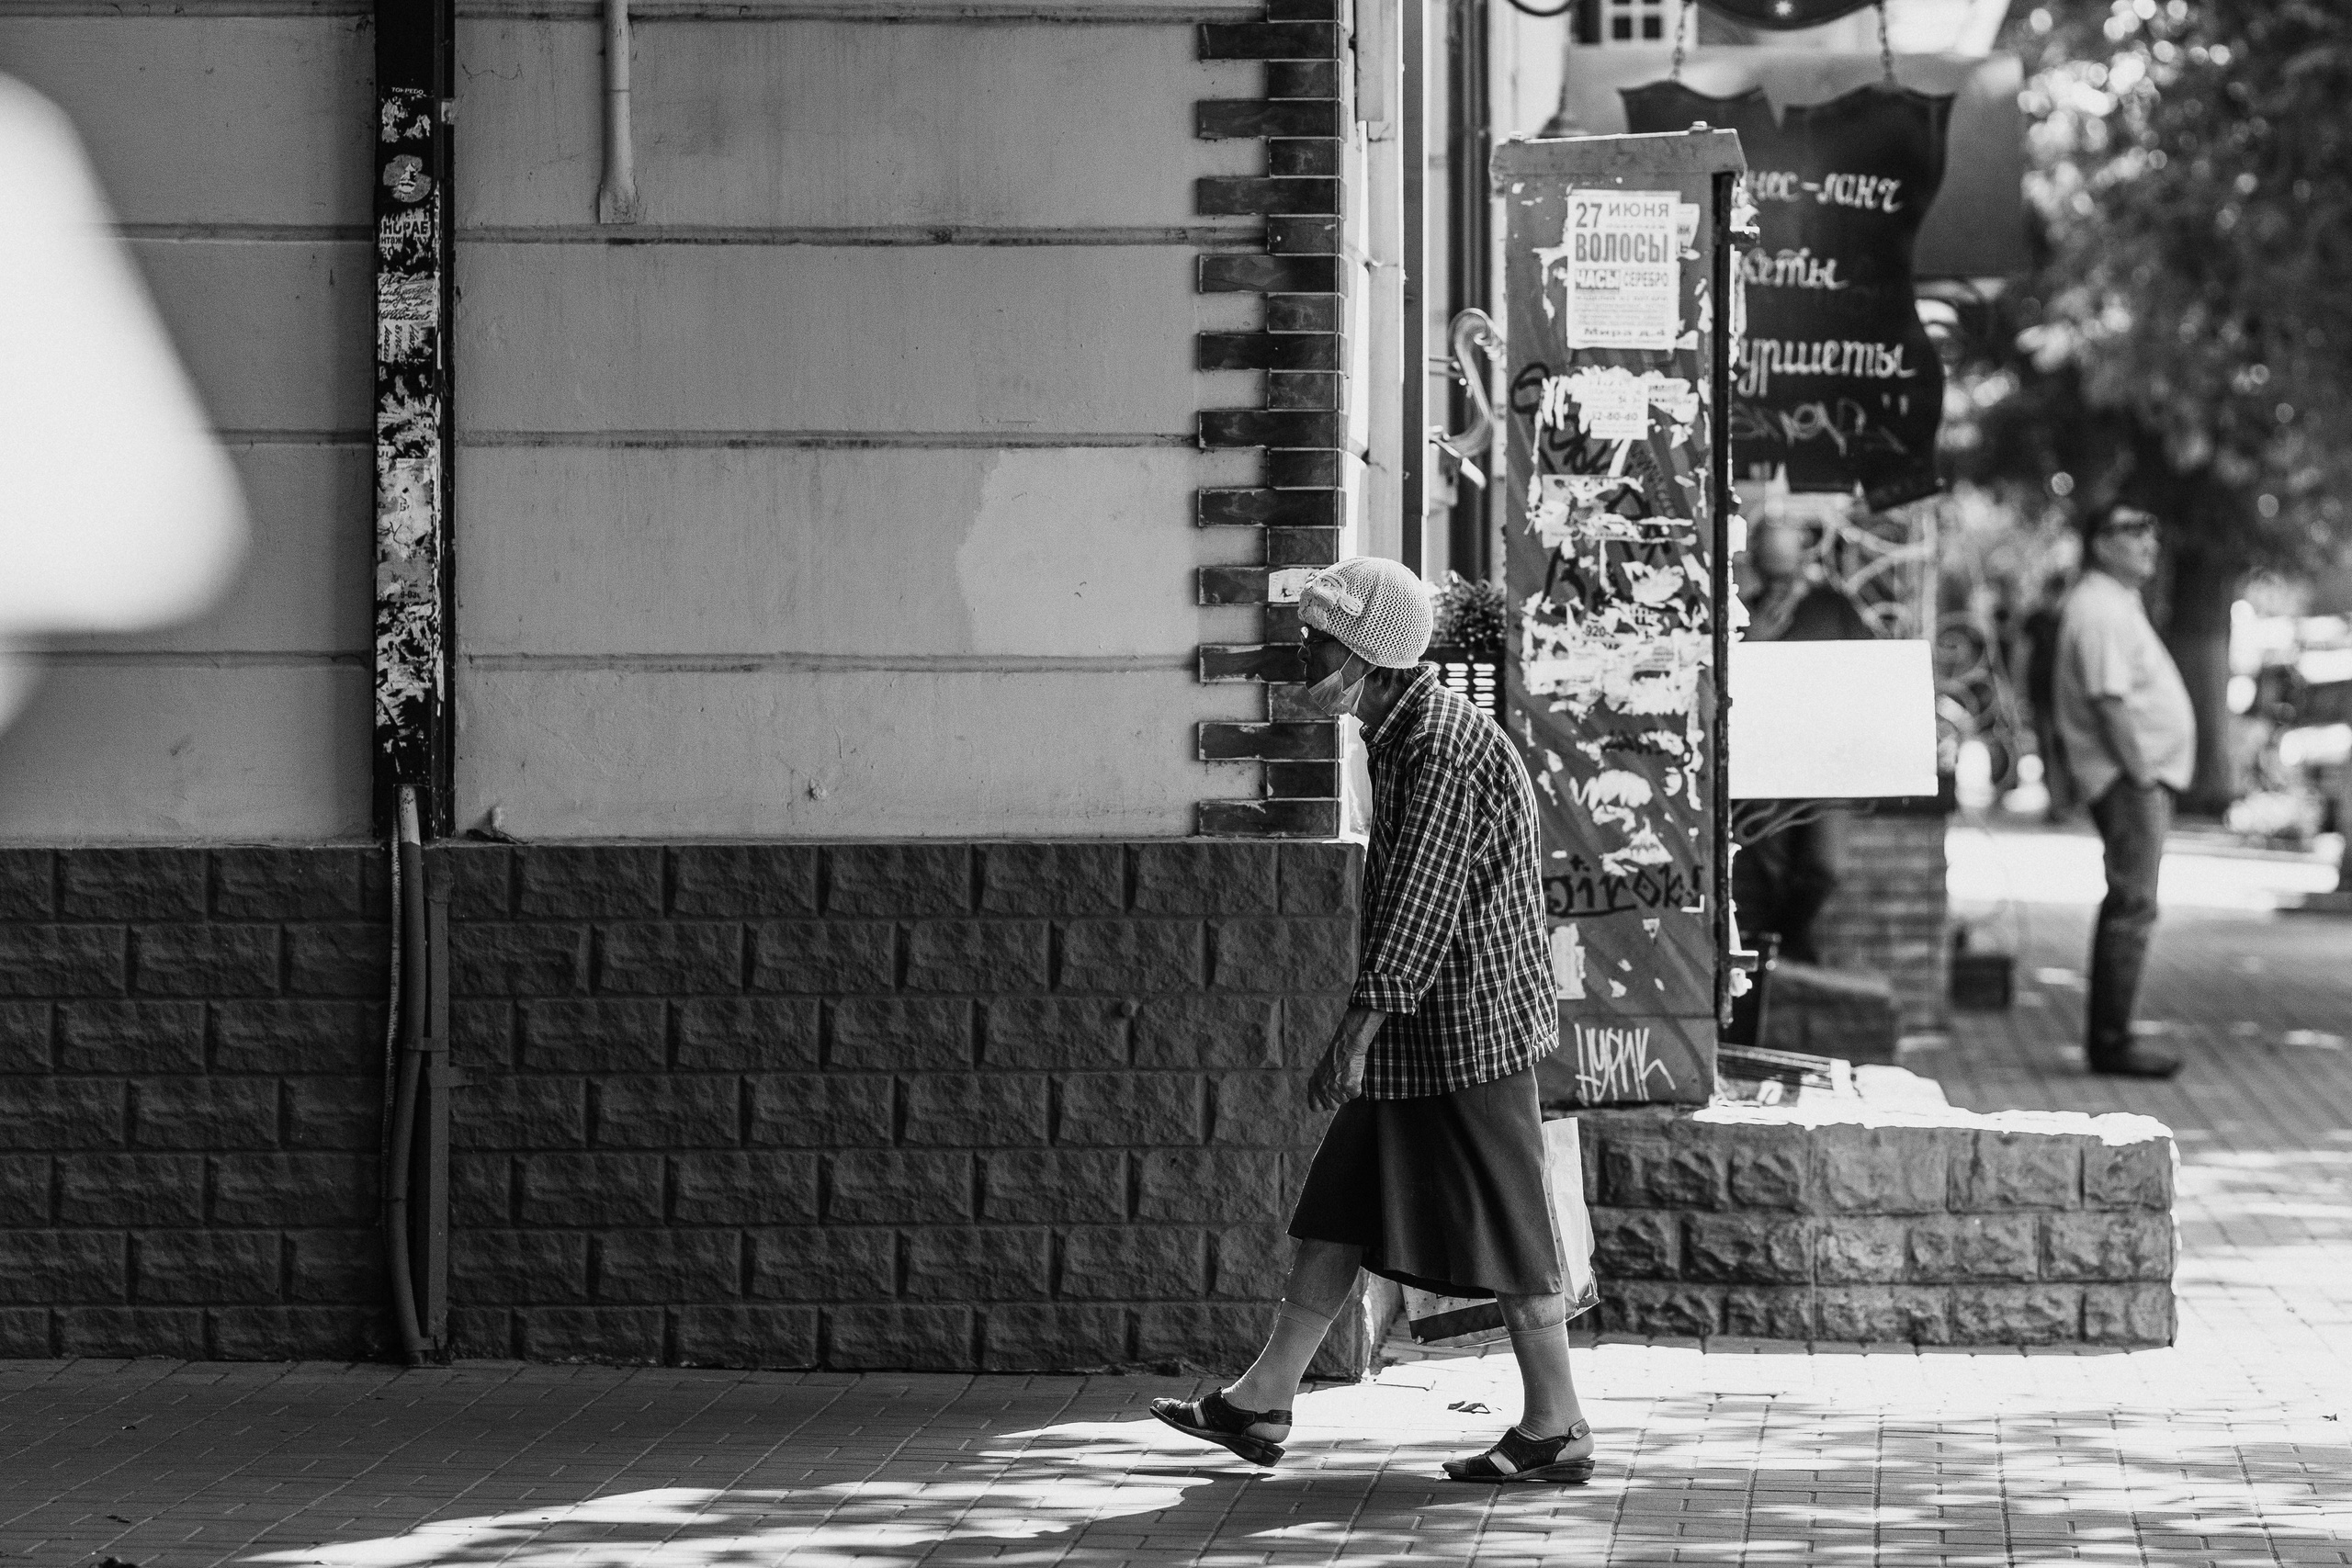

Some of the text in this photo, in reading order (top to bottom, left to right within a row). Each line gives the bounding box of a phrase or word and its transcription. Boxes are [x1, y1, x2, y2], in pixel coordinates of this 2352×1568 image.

[1744, 170, 1902, 213] нес-ланч
[379, 220, 429, 235] НОРАБ
[1576, 202, 1668, 228] 27 ИЮНЯ
[1576, 232, 1668, 263] ВОЛОСЫ
[1576, 269, 1619, 289] ЧАСЫ
[1737, 338, 1917, 399] уршеты
